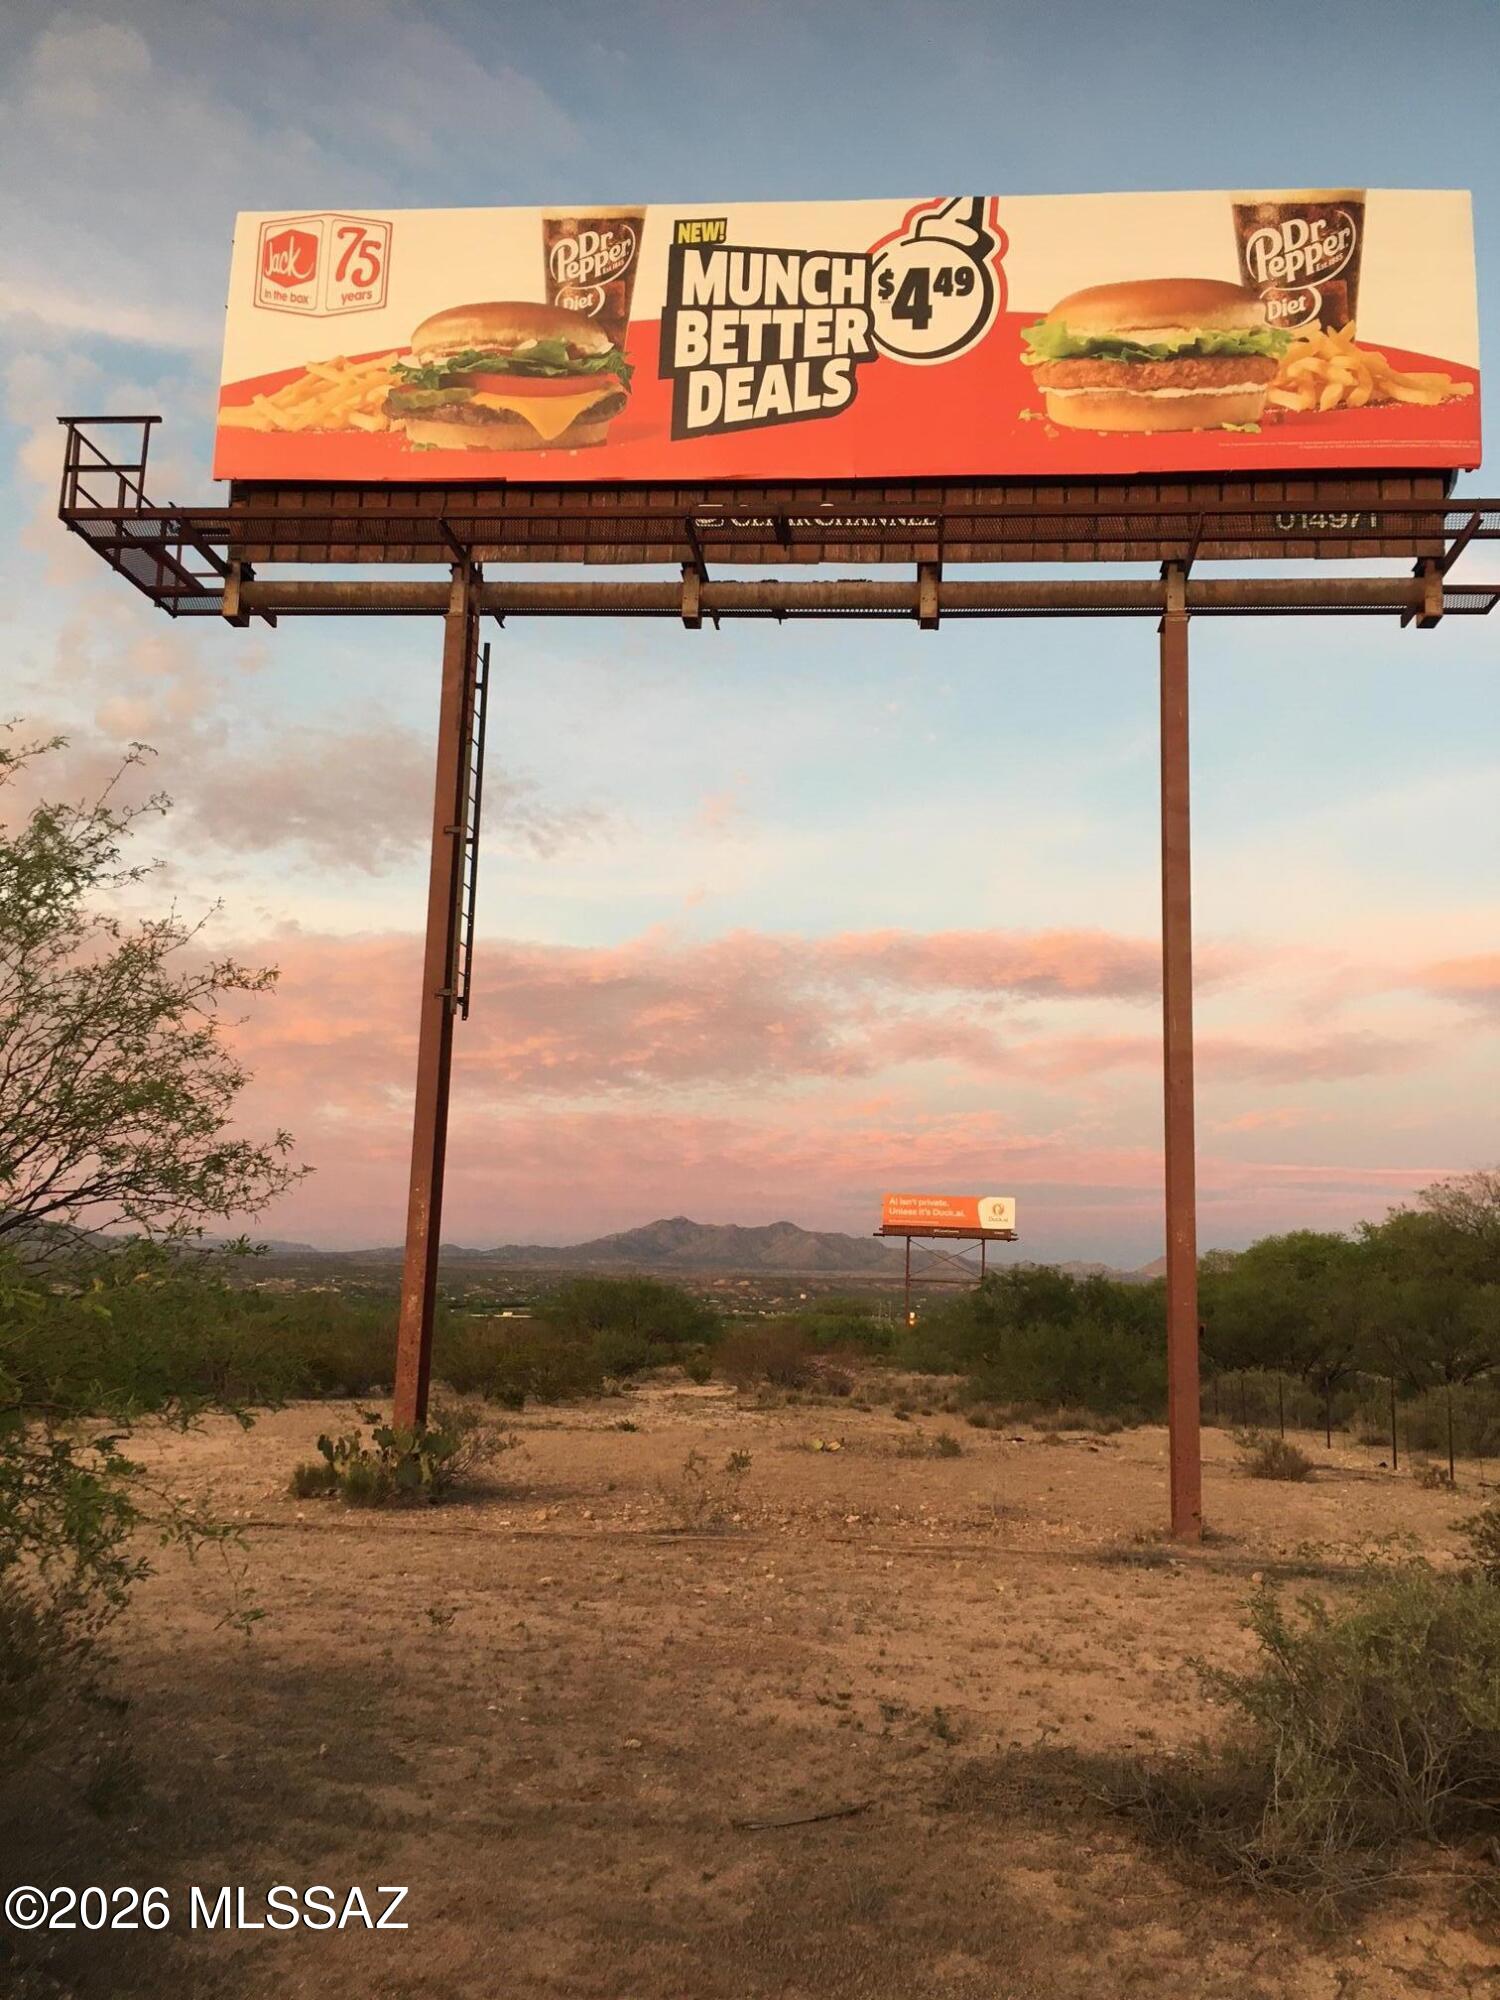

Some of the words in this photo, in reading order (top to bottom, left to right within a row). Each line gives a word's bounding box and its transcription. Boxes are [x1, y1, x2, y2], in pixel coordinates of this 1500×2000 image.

[578, 230, 614, 260] Dr
[677, 221, 726, 244] NEW!
[1246, 227, 1351, 283] Pepper
[1281, 218, 1327, 254] Dr
[264, 235, 315, 280] Jack
[335, 226, 382, 288] 75
[550, 238, 632, 284] Pepper
[681, 249, 867, 307] MUNCH
[264, 288, 273, 299] in
[273, 289, 289, 302] the
[290, 291, 309, 304] box
[341, 290, 373, 306] years
[1267, 295, 1307, 321] Diet
[673, 308, 870, 369] BETTER
[686, 358, 853, 430] DEALS
